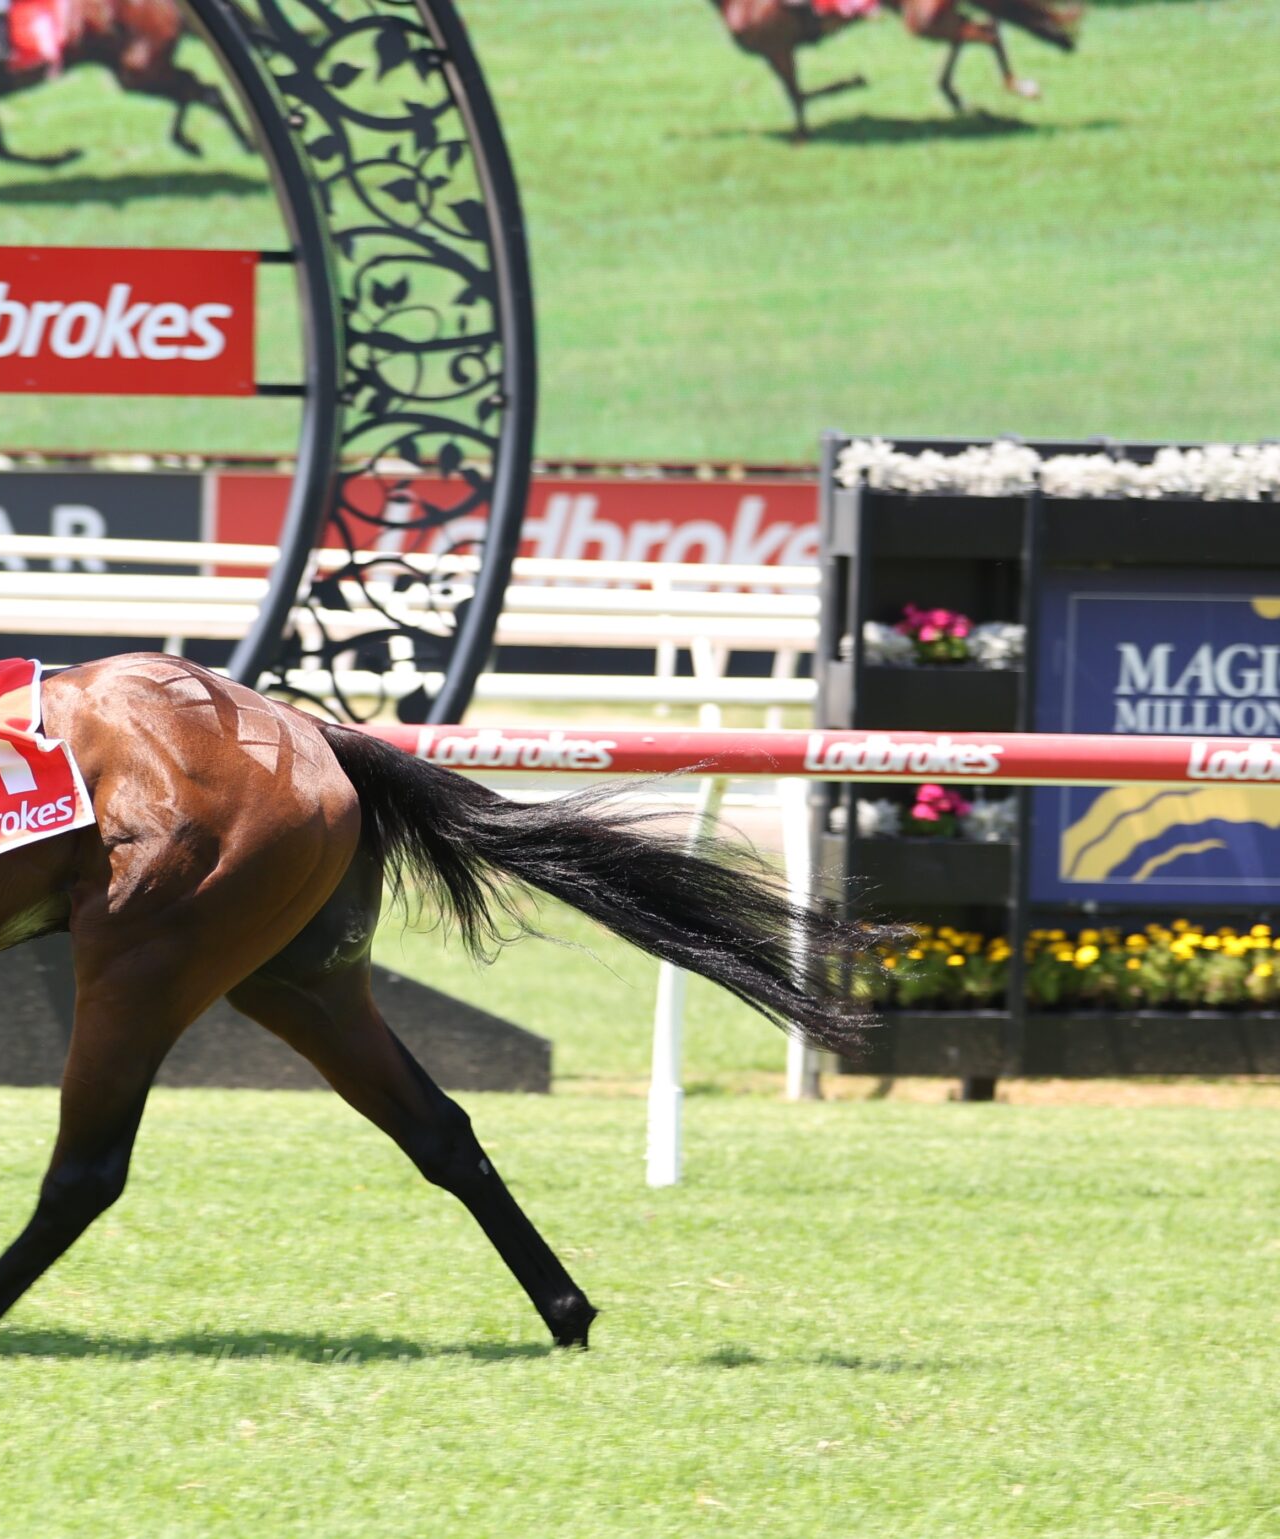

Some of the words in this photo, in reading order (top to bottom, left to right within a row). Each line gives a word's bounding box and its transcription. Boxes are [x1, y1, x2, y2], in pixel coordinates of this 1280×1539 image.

[1114, 643, 1280, 697] MAGI
[415, 728, 617, 769] Ladbrokes
[804, 735, 1004, 774] Ladbrokes
